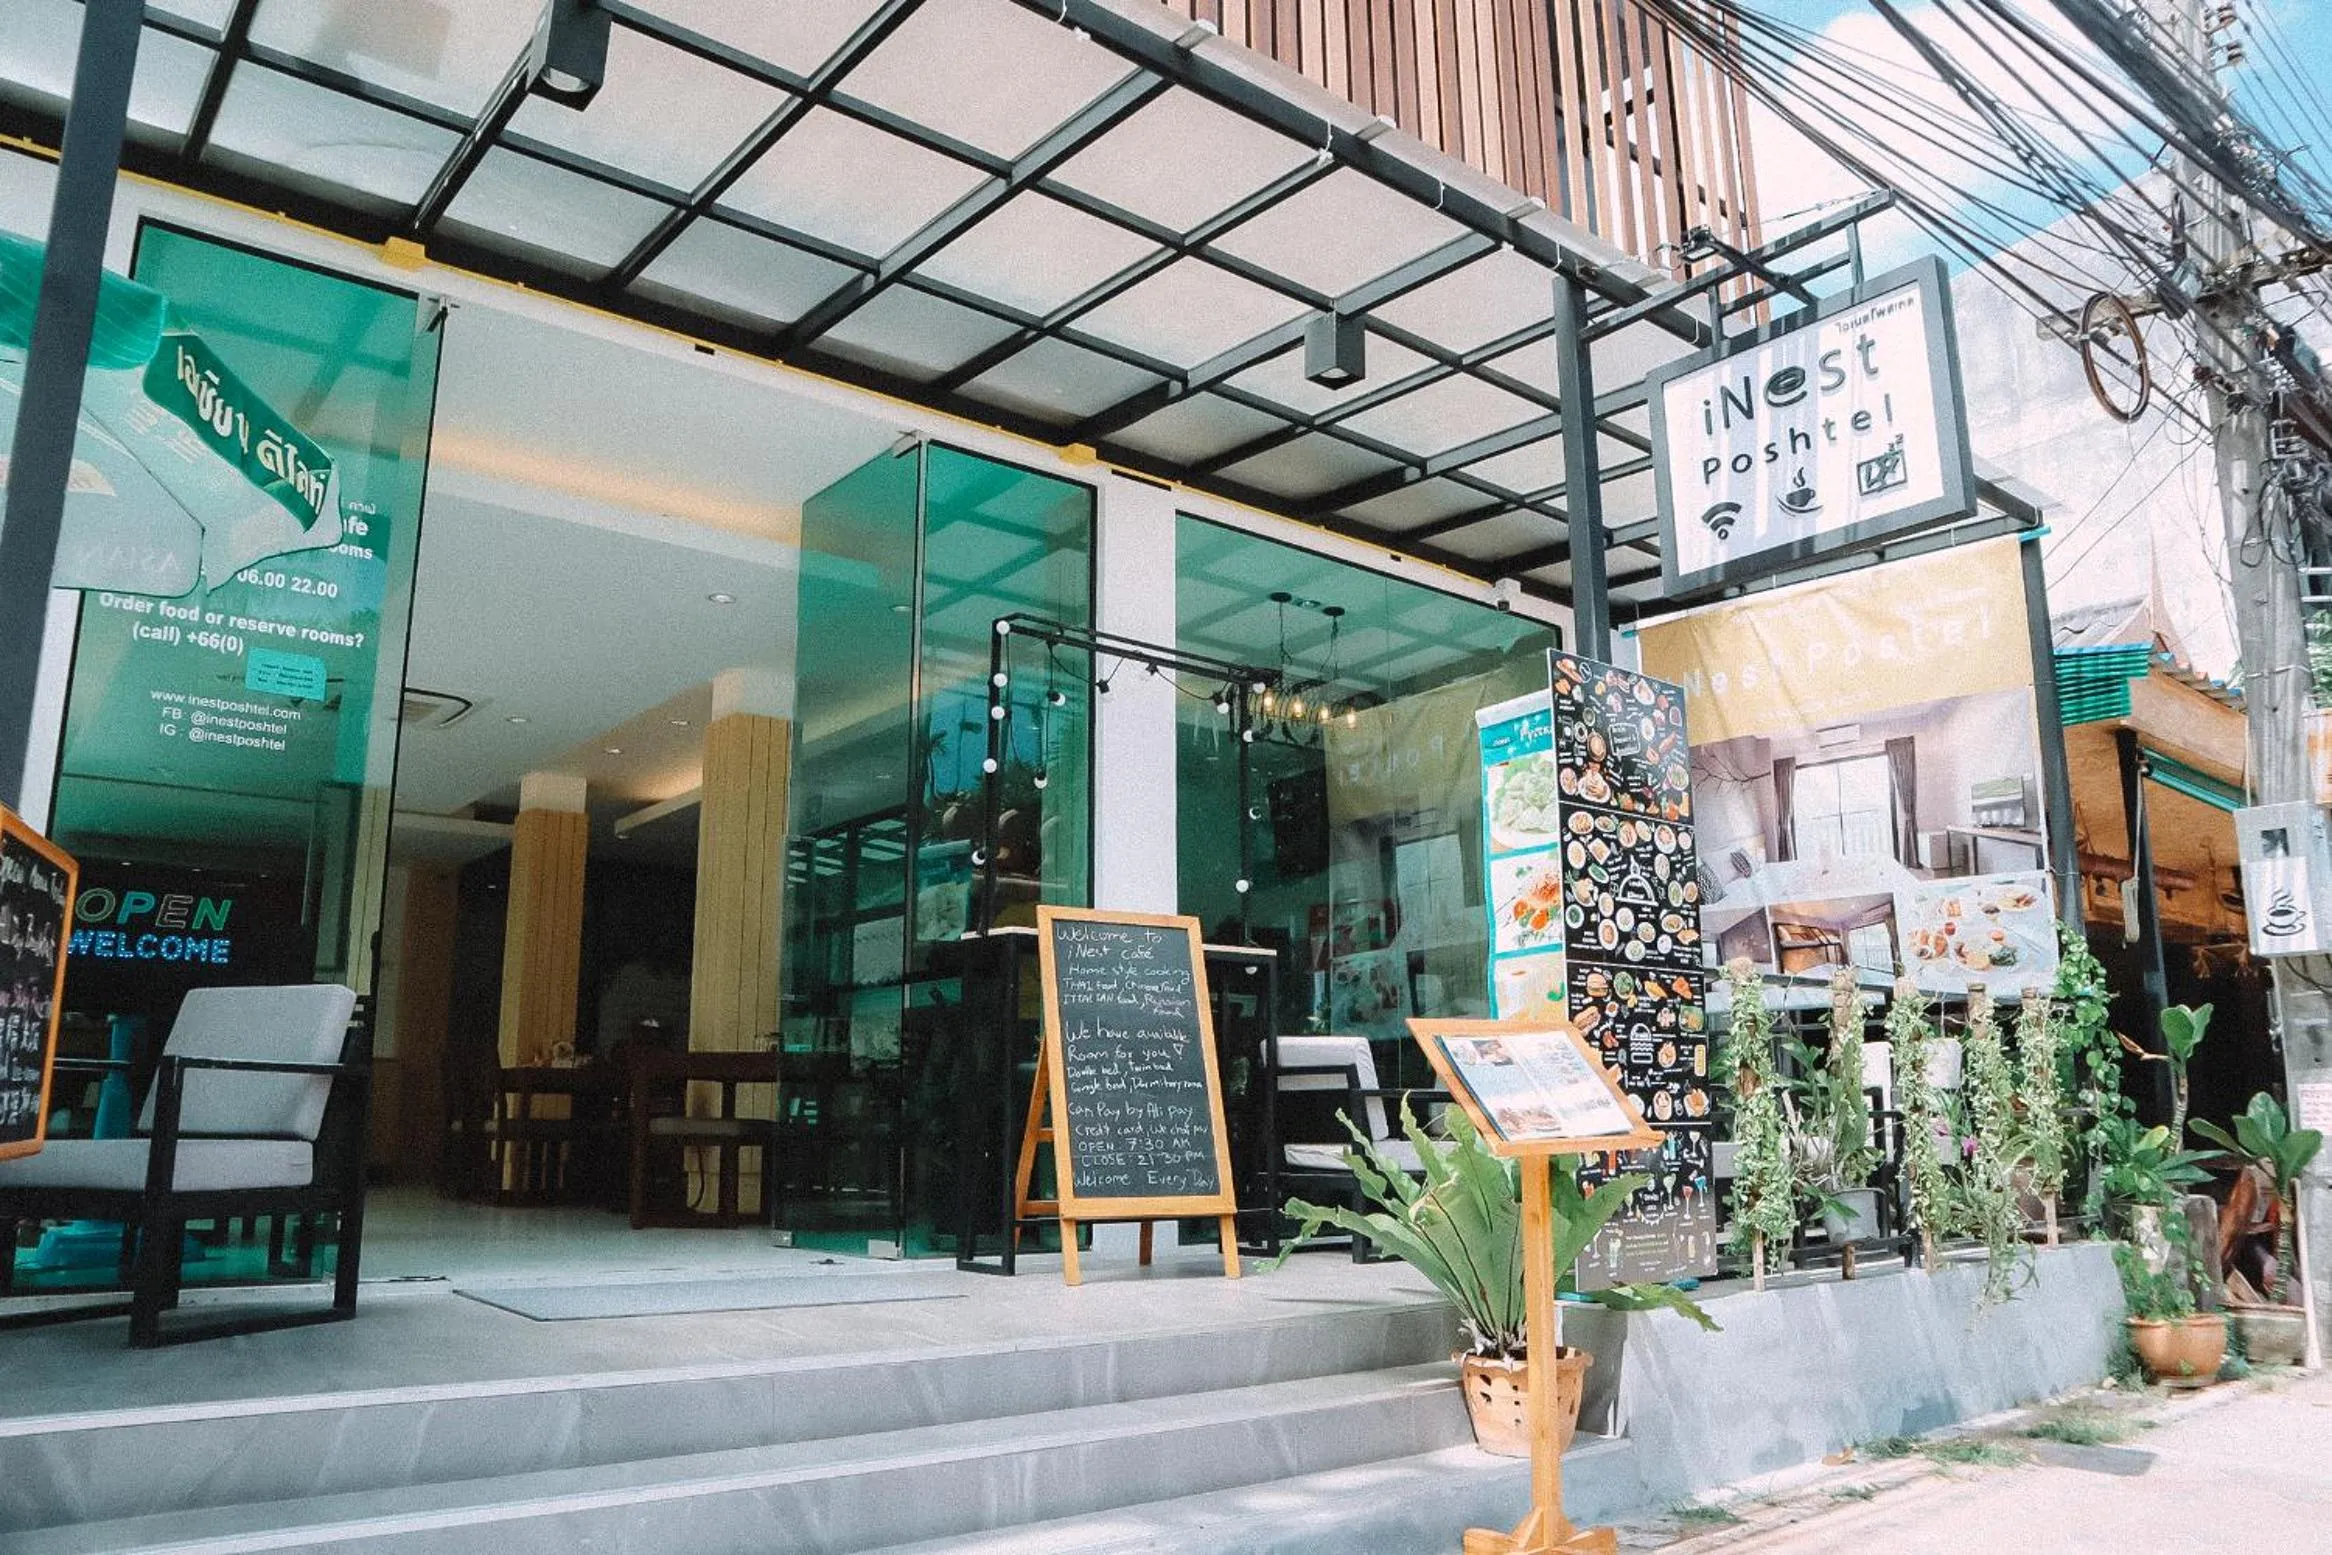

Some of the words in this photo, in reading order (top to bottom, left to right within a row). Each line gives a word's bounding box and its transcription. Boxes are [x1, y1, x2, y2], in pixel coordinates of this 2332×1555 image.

[291, 576, 338, 599] 22.00
[100, 592, 152, 614] Order
[159, 601, 200, 622] food
[205, 612, 223, 625] or
[228, 615, 297, 637] reserve
[301, 629, 365, 648] rooms?
[133, 621, 181, 646] (call)
[187, 632, 244, 655] +66(0)
[150, 690, 302, 721] www.inestposhtel.com
[162, 706, 182, 720] FB
[191, 710, 287, 734] @inestposhtel
[159, 723, 177, 736] IG
[189, 727, 286, 751] @inestposhtel
[75, 887, 232, 931] OPEN
[67, 929, 231, 964] WELCOME
[1056, 925, 1133, 943] Welcome
[1144, 928, 1163, 943] to
[1069, 964, 1107, 976] Home
